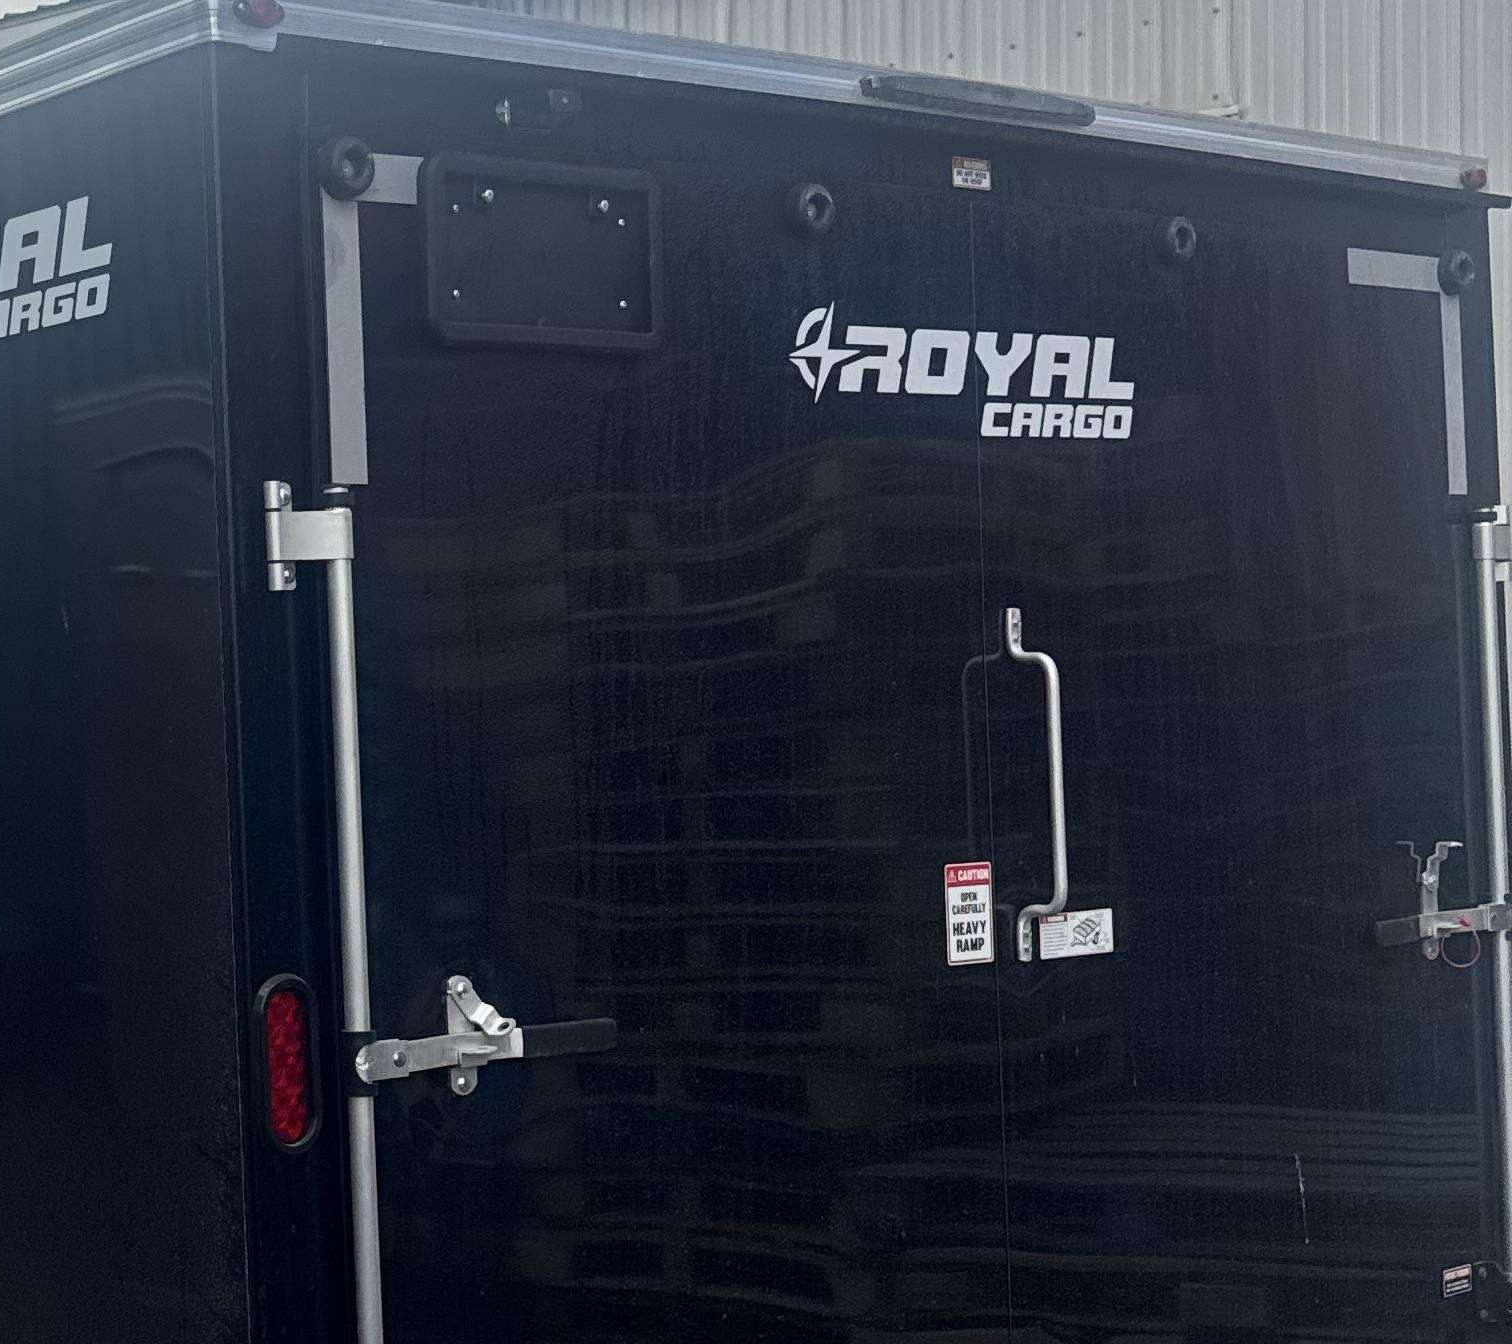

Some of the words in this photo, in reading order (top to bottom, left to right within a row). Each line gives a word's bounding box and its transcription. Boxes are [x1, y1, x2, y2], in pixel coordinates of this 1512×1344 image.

[838, 325, 1135, 400] ROYAL
[980, 402, 1134, 439] CARGO
[957, 869, 989, 882] CAUTION
[960, 892, 977, 902] OPEN
[952, 903, 986, 915] CAREFULLY
[953, 920, 986, 936] HEAVY
[956, 937, 985, 953] RAMP
